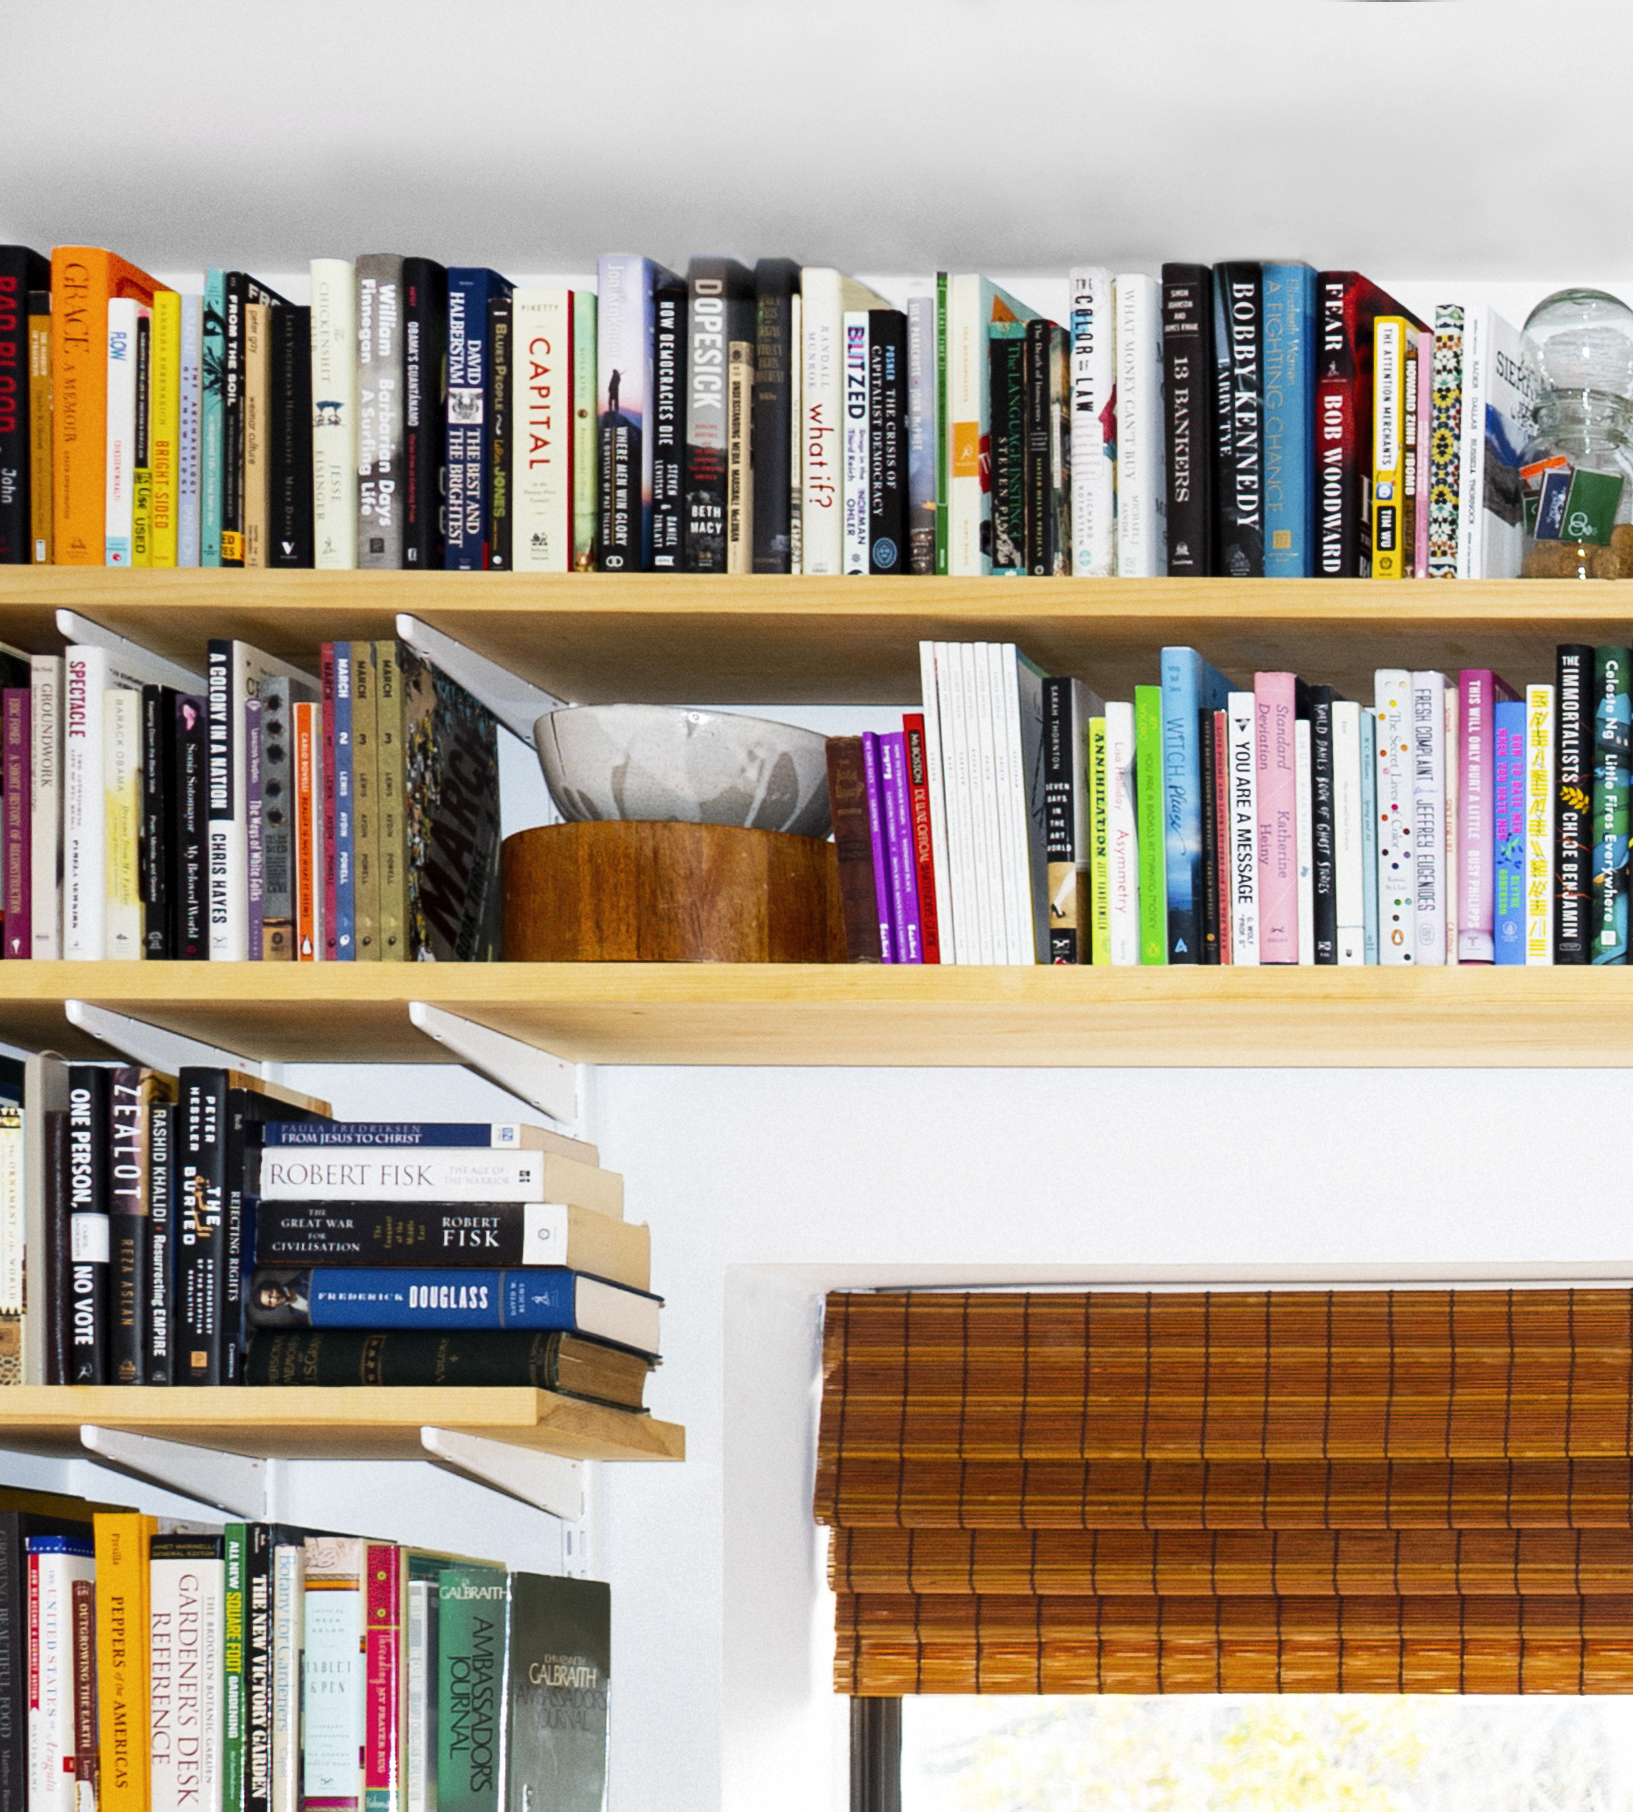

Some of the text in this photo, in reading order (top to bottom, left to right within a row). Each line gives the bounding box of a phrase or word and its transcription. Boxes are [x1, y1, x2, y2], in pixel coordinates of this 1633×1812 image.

[450, 292, 464, 384] HALBERSTAM
[468, 340, 481, 384] DAVID
[692, 279, 723, 409] DOPESICK
[848, 327, 865, 419] BLITZED
[529, 338, 551, 469] CAPITAL
[809, 404, 835, 508] what if?
[1174, 357, 1190, 502] 13 BANKERS
[1233, 284, 1258, 529] BOBBY KENNEDY
[1322, 284, 1344, 572] FEAR BOB WOODWARD
[69, 661, 85, 737] SPECTACLE
[210, 653, 227, 808] A COLONY IN A NATION
[1563, 668, 1579, 783] IMMORTALISTS
[212, 834, 226, 923] CHRIS HAYES
[1236, 742, 1253, 903] YOU ARE A MESSAGE
[70, 1089, 91, 1207] ONE PERSON,
[115, 1085, 141, 1200] ZEALOT
[271, 1164, 434, 1185] ROBERT FISK
[151, 1109, 166, 1356] RASHID KHALIDI Resurrecting EMPIRE
[281, 1219, 353, 1228] GREAT WAR
[443, 1217, 498, 1227] ROBERT
[444, 1230, 499, 1247] FISK
[73, 1266, 93, 1345] NO VOTE
[409, 1285, 488, 1309] DOUGLASS
[151, 1613, 170, 1765] REFERENCE
[178, 1574, 199, 1805] GARDENER'S DESK
[252, 1575, 266, 1798] THE NEW VICTORY GARDEN
[449, 1657, 471, 1759] JOURNAL
[471, 1617, 494, 1792] AMBASSADOR'S
